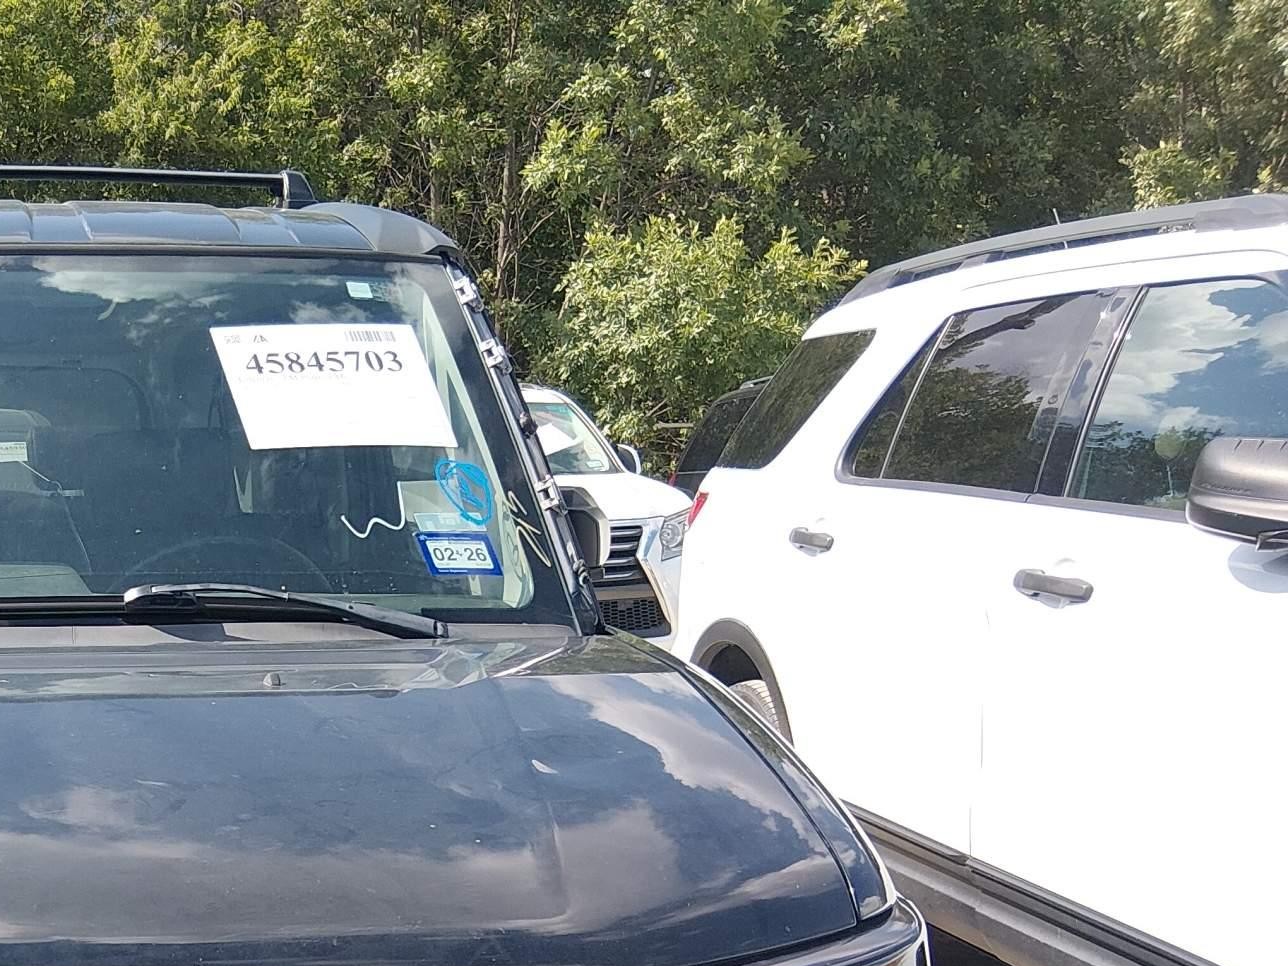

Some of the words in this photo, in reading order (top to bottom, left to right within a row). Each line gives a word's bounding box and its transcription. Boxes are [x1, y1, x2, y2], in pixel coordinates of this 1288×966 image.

[246, 350, 404, 374] 45845703
[432, 547, 458, 561] 02
[463, 547, 487, 561] 26
